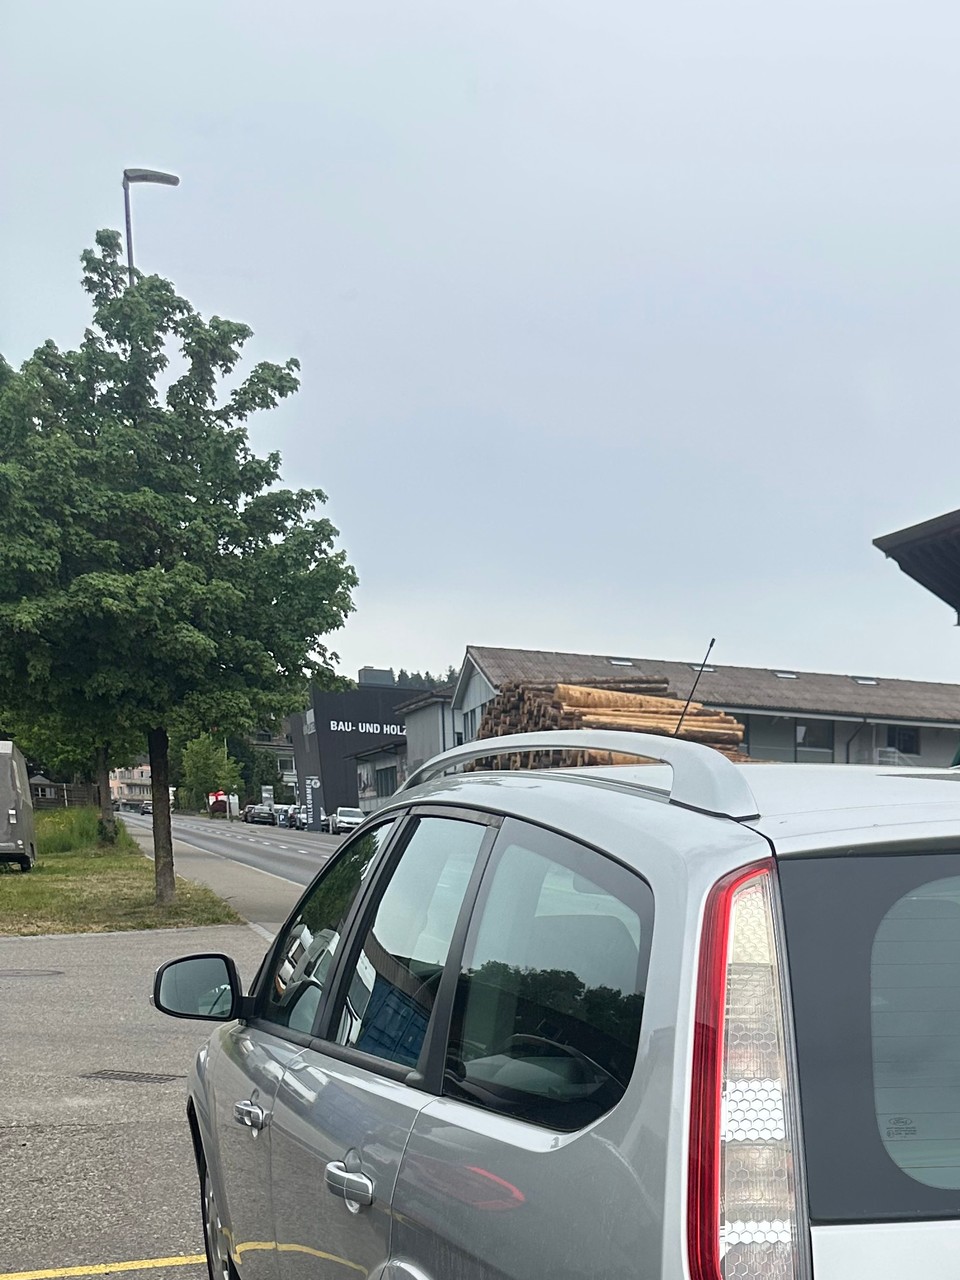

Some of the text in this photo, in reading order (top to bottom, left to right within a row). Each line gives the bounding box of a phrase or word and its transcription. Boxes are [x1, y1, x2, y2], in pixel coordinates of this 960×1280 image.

[330, 720, 356, 732] BAU-
[358, 722, 381, 734] UND
[305, 779, 314, 824] WILLKOMMEN
